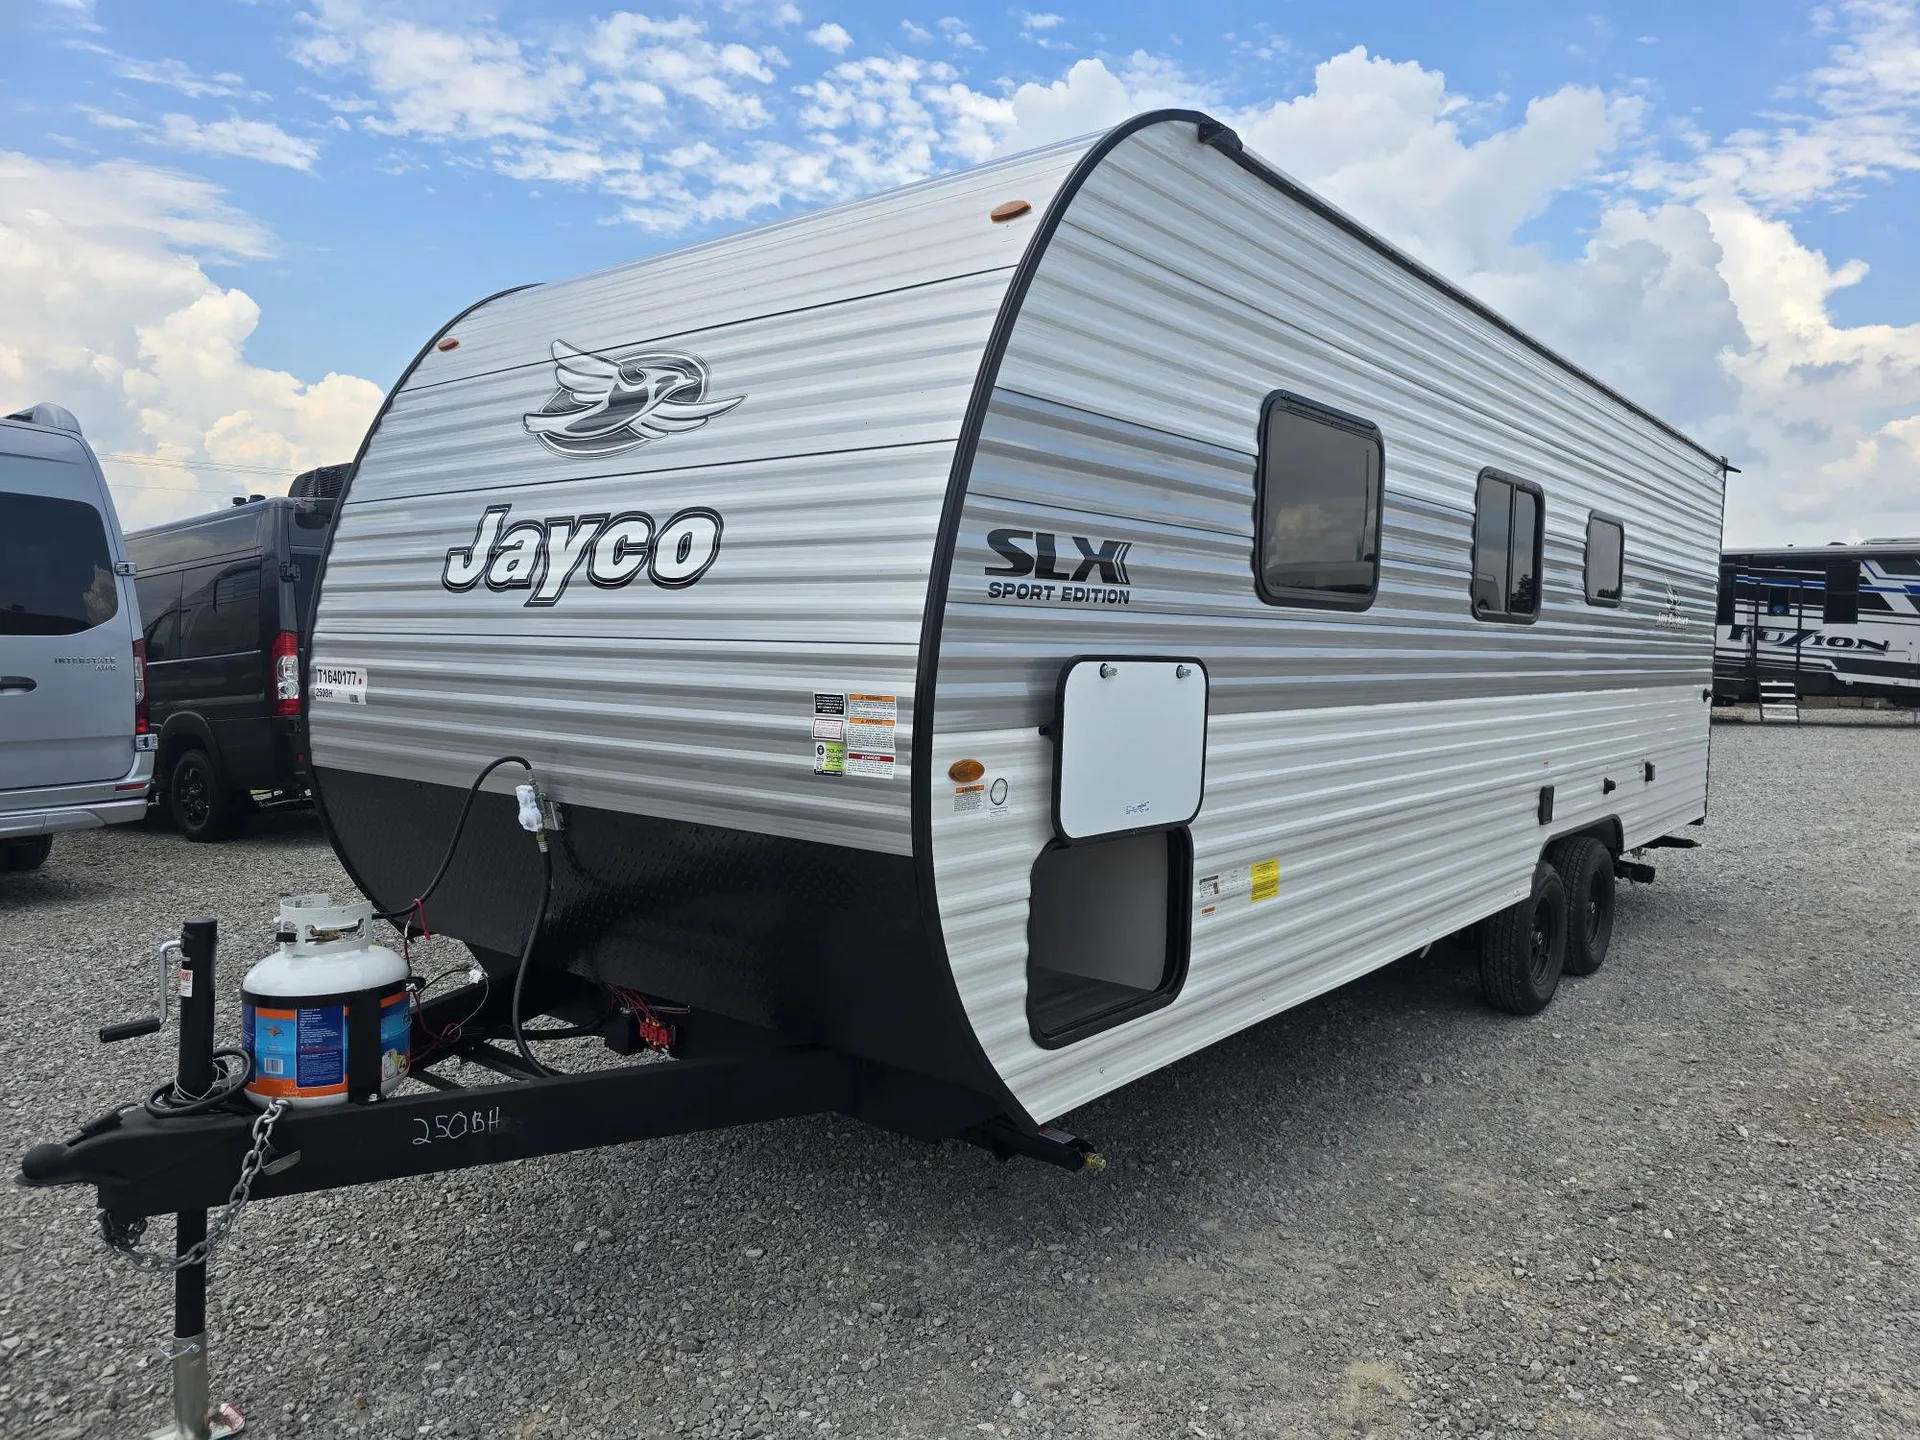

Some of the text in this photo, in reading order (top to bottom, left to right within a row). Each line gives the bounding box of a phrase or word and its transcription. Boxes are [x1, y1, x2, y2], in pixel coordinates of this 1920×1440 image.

[441, 503, 724, 607] Jayco
[985, 528, 1132, 585] SLX
[988, 581, 1131, 605] SPORT EDITION
[317, 669, 357, 686] T1640177
[412, 1106, 500, 1145] 250BH
